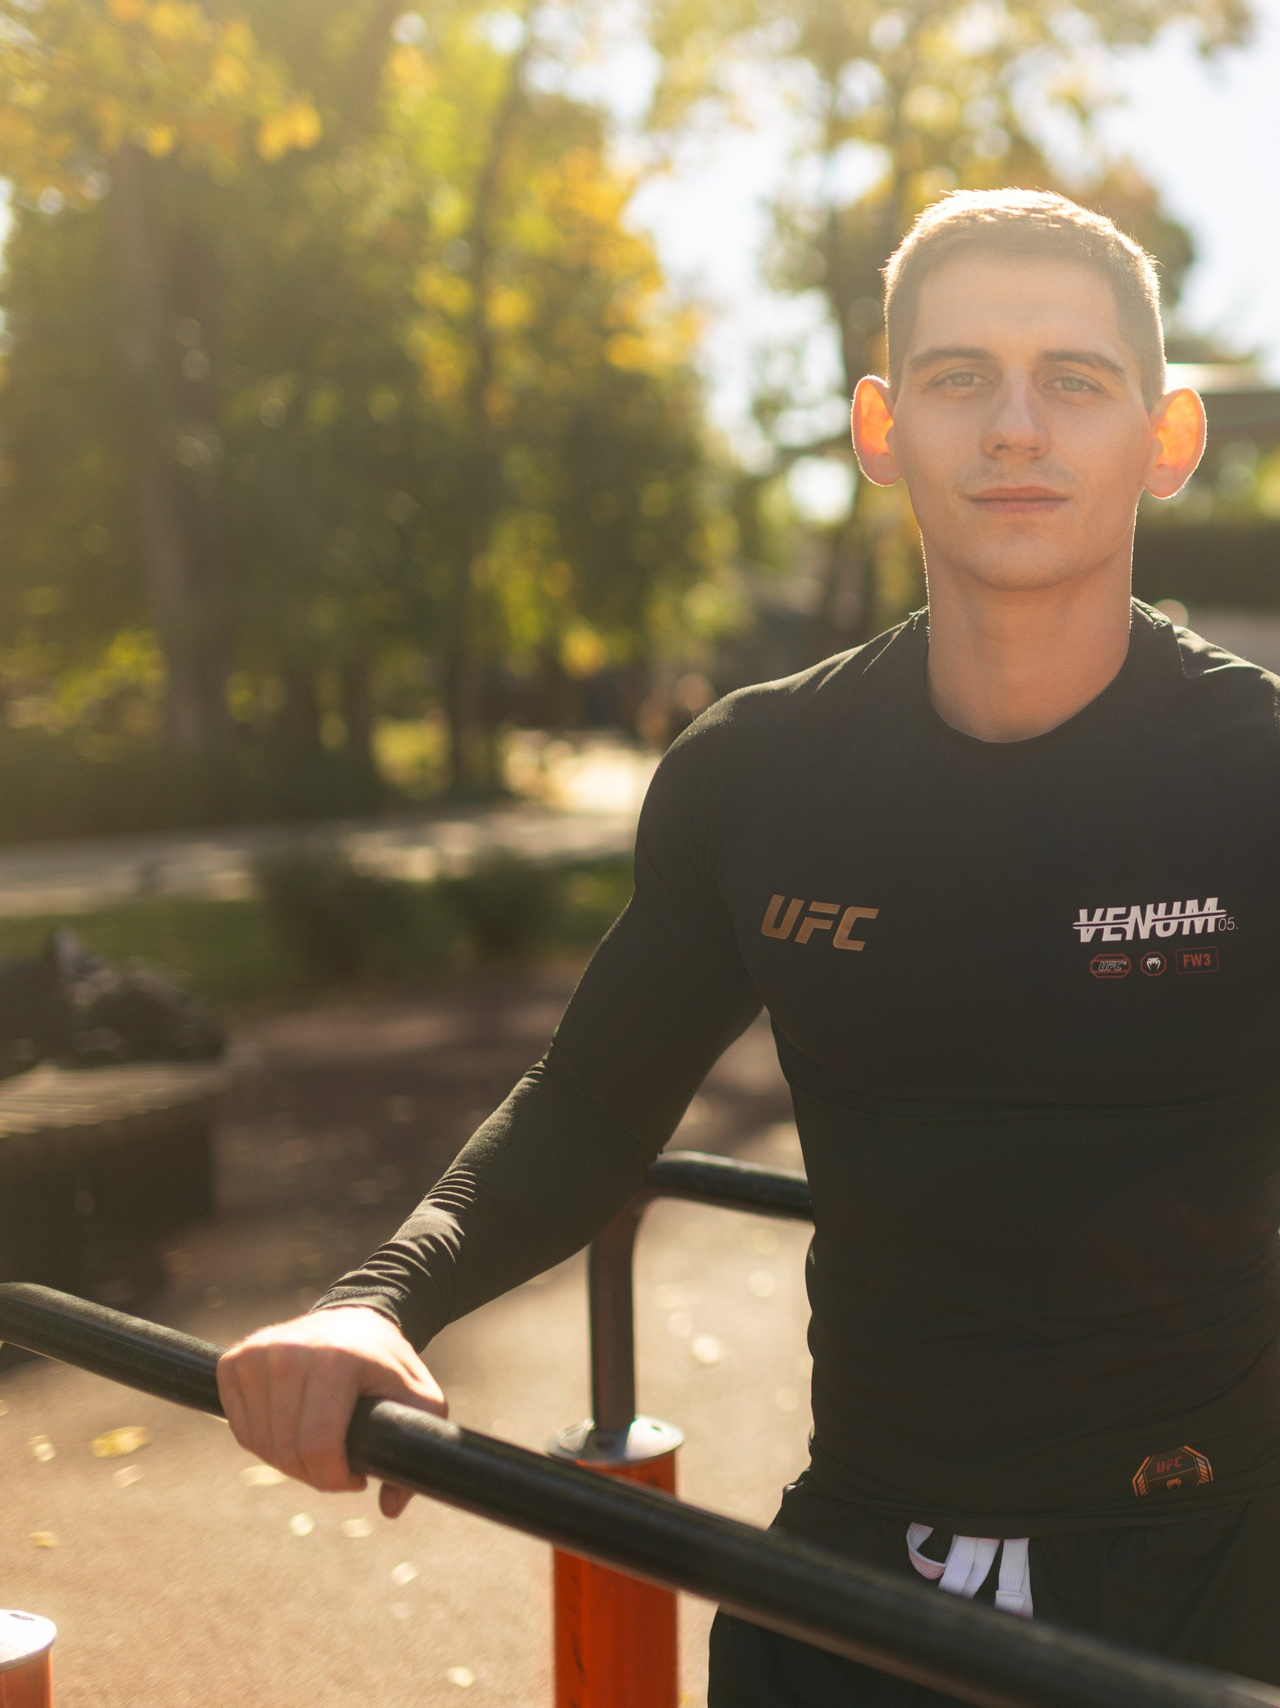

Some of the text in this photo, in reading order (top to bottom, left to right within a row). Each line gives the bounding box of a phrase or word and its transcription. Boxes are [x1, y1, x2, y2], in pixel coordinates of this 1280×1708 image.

[761, 894, 880, 951] UFC
[1073, 897, 1227, 943] VENUM
[1183, 953, 1211, 968] FW3
[1156, 1456, 1183, 1473] UFC
